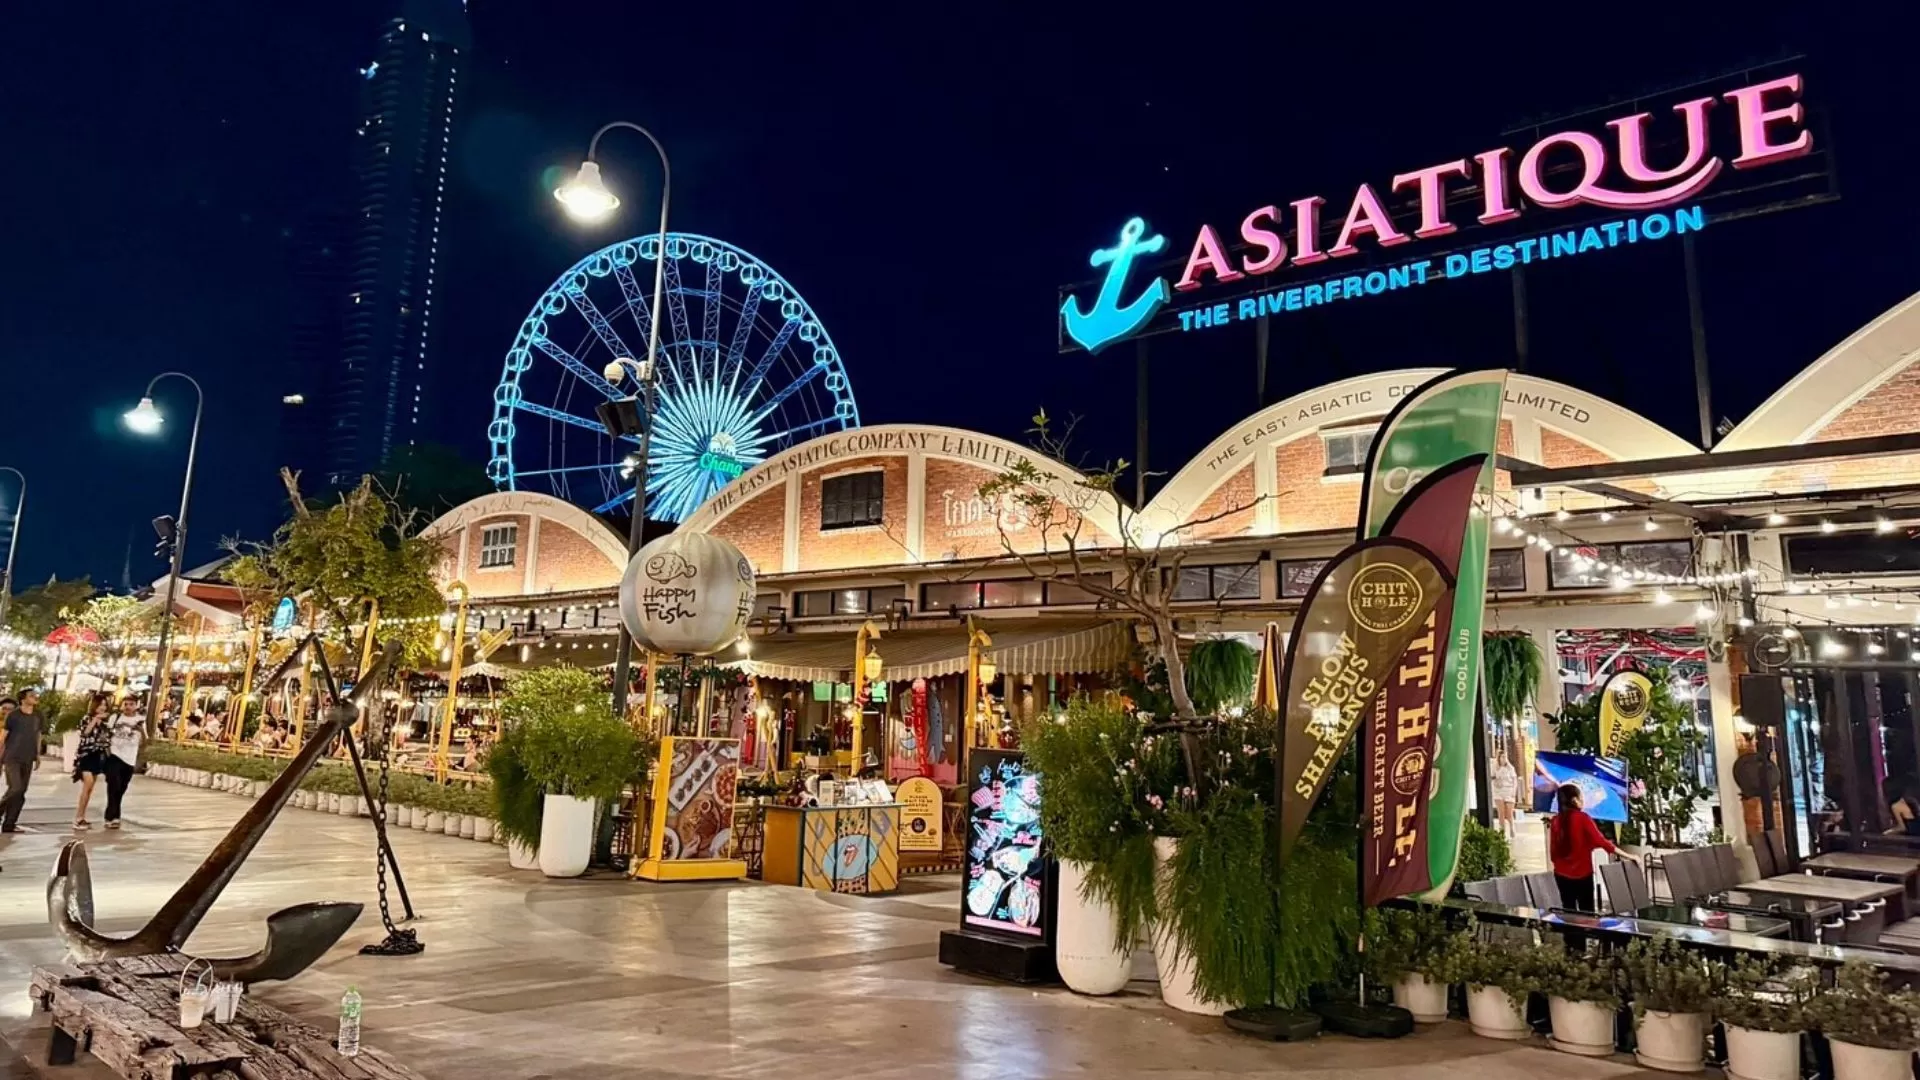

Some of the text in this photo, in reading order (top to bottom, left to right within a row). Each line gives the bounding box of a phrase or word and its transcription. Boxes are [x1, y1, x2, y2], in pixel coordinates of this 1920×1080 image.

[1174, 73, 1814, 290] ASIATIQUE
[1178, 206, 1703, 332] THE RIVERFRONT DESTINATION
[701, 452, 743, 478] Chang
[1206, 444, 1239, 471] THE
[1242, 415, 1288, 447] EAST
[1298, 390, 1373, 422] ASIATIC
[1503, 389, 1591, 424] LIMITED
[711, 492, 737, 516] THE
[738, 465, 775, 497] EAST
[779, 439, 840, 477] ASIATIC
[848, 431, 930, 452] COMPANY
[643, 586, 696, 603] Happy
[643, 602, 697, 624] Fish
[1361, 582, 1408, 596] CHIT
[1361, 596, 1409, 610] HOLE
[1302, 630, 1356, 707] SLOW
[1304, 652, 1369, 741] FOCUS
[1456, 628, 1470, 700] COOL CLUB
[1295, 676, 1375, 800] SHAKING
[1373, 688, 1388, 838] THAI CRAFT BEER
